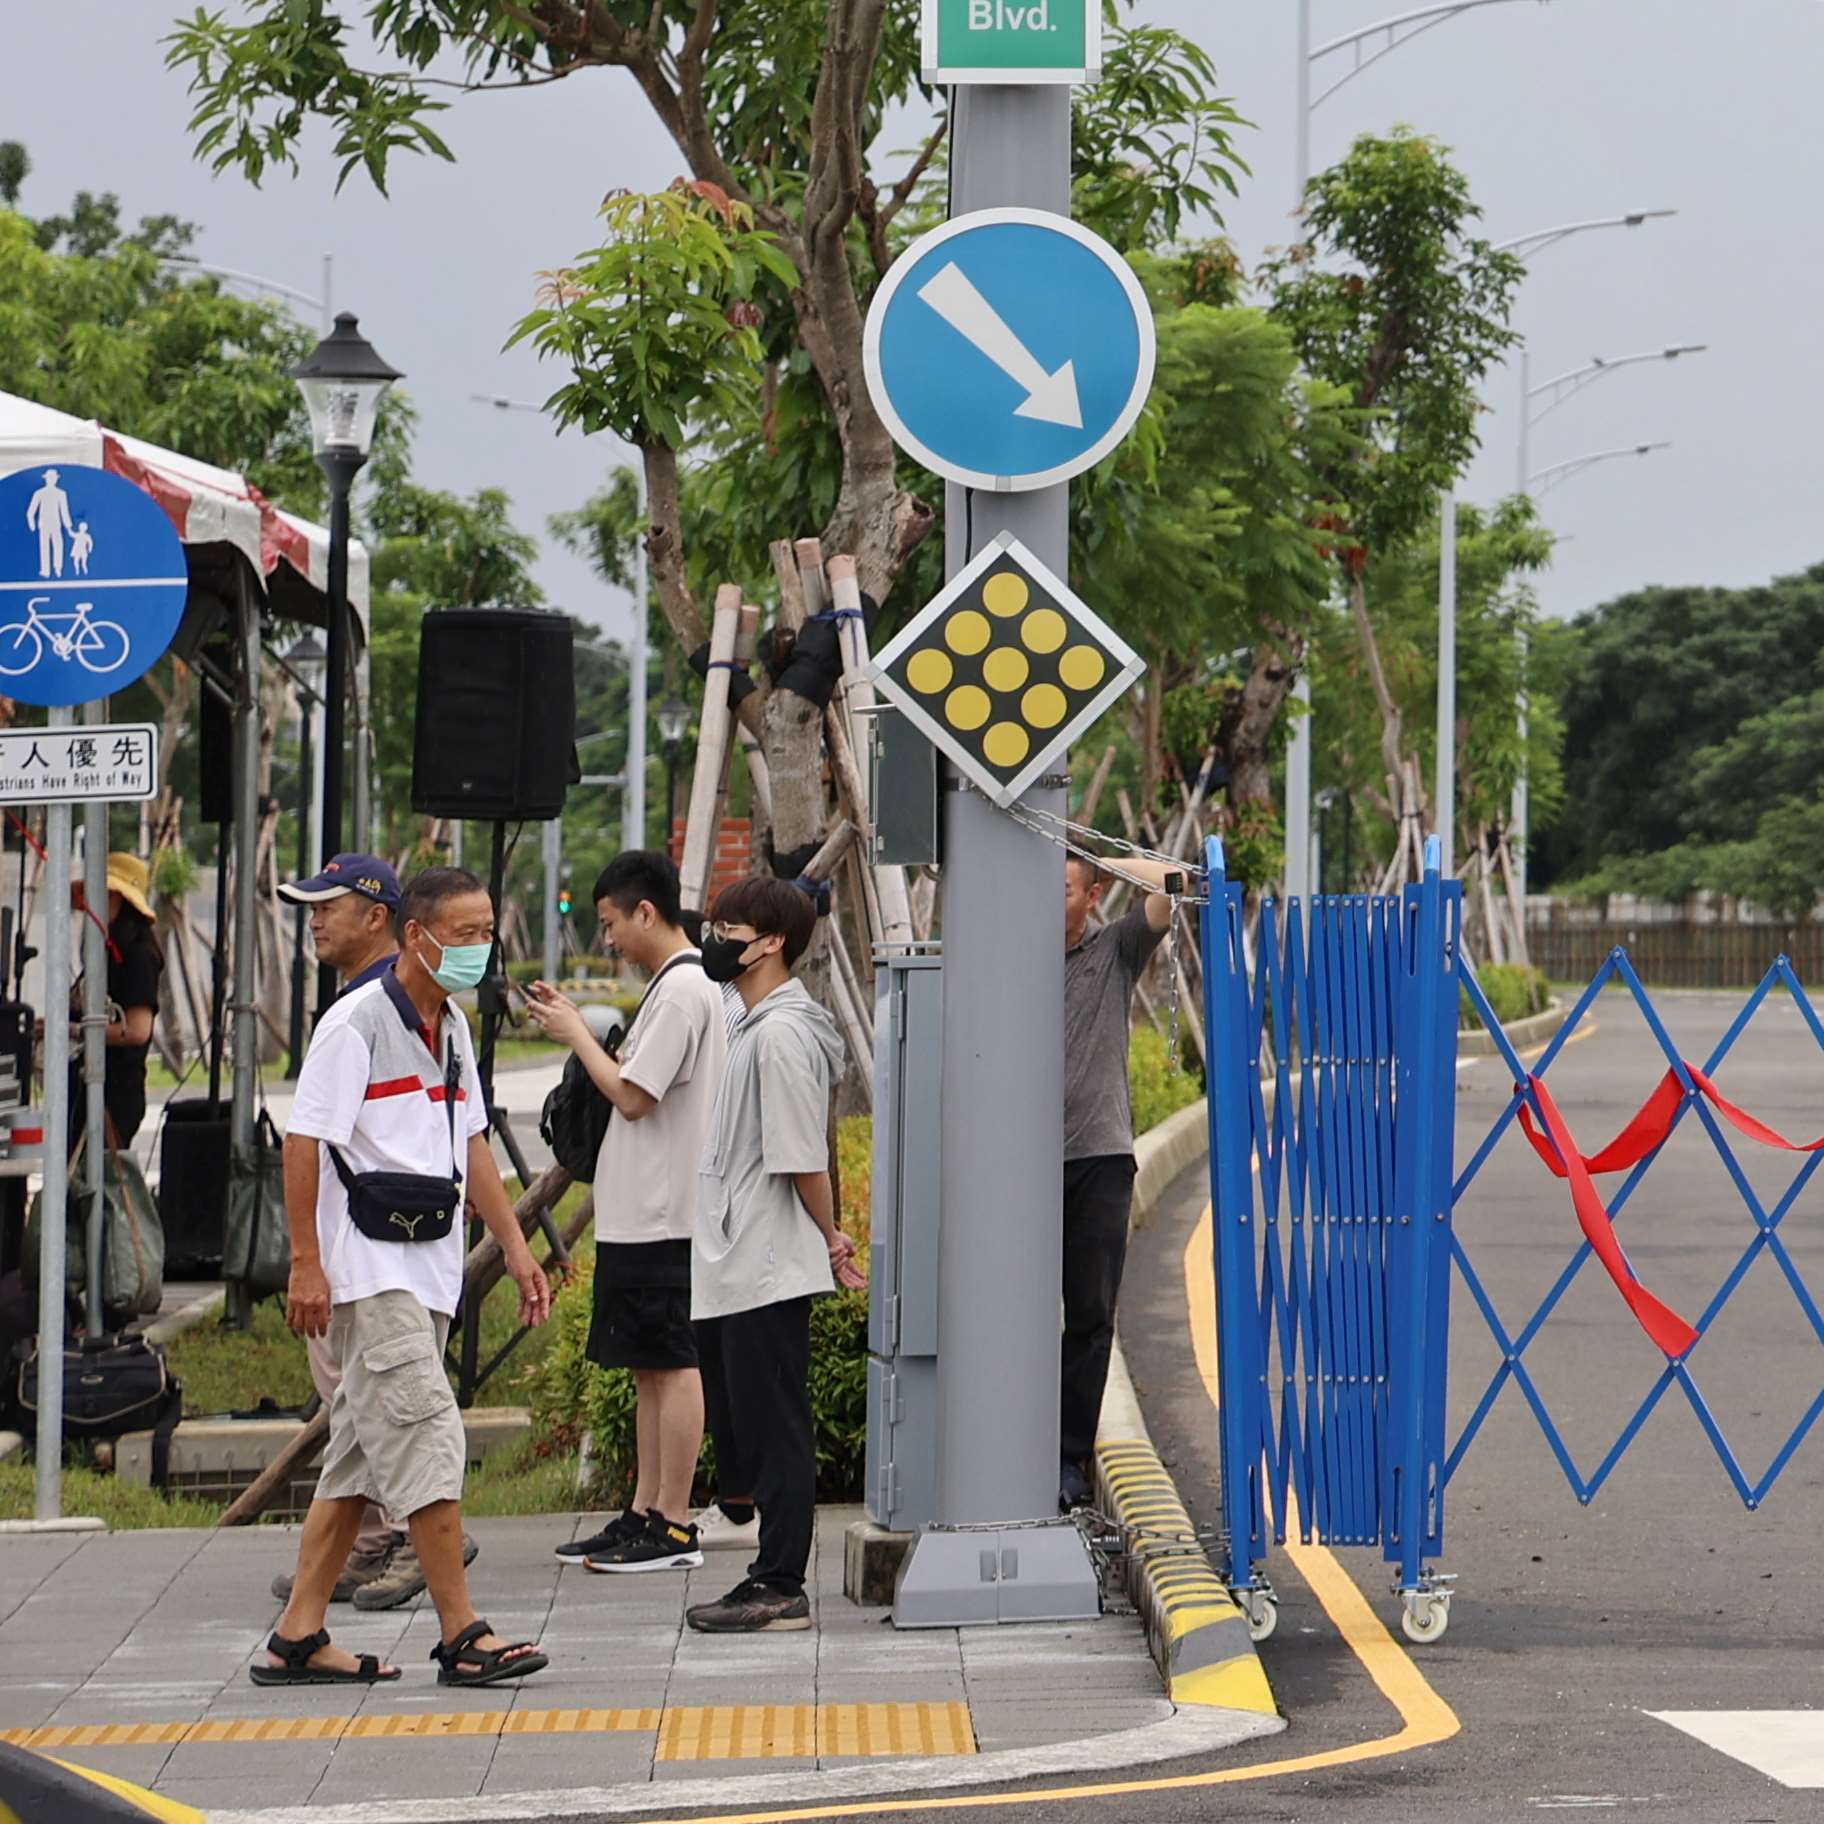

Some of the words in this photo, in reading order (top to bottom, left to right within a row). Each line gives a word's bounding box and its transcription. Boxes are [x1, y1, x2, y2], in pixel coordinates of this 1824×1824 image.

[968, 0, 1057, 32] Blvd.
[0, 736, 144, 769] 人優先
[42, 774, 66, 789] Have
[73, 773, 100, 791] Right
[106, 771, 117, 786] of
[122, 771, 142, 789] Way
